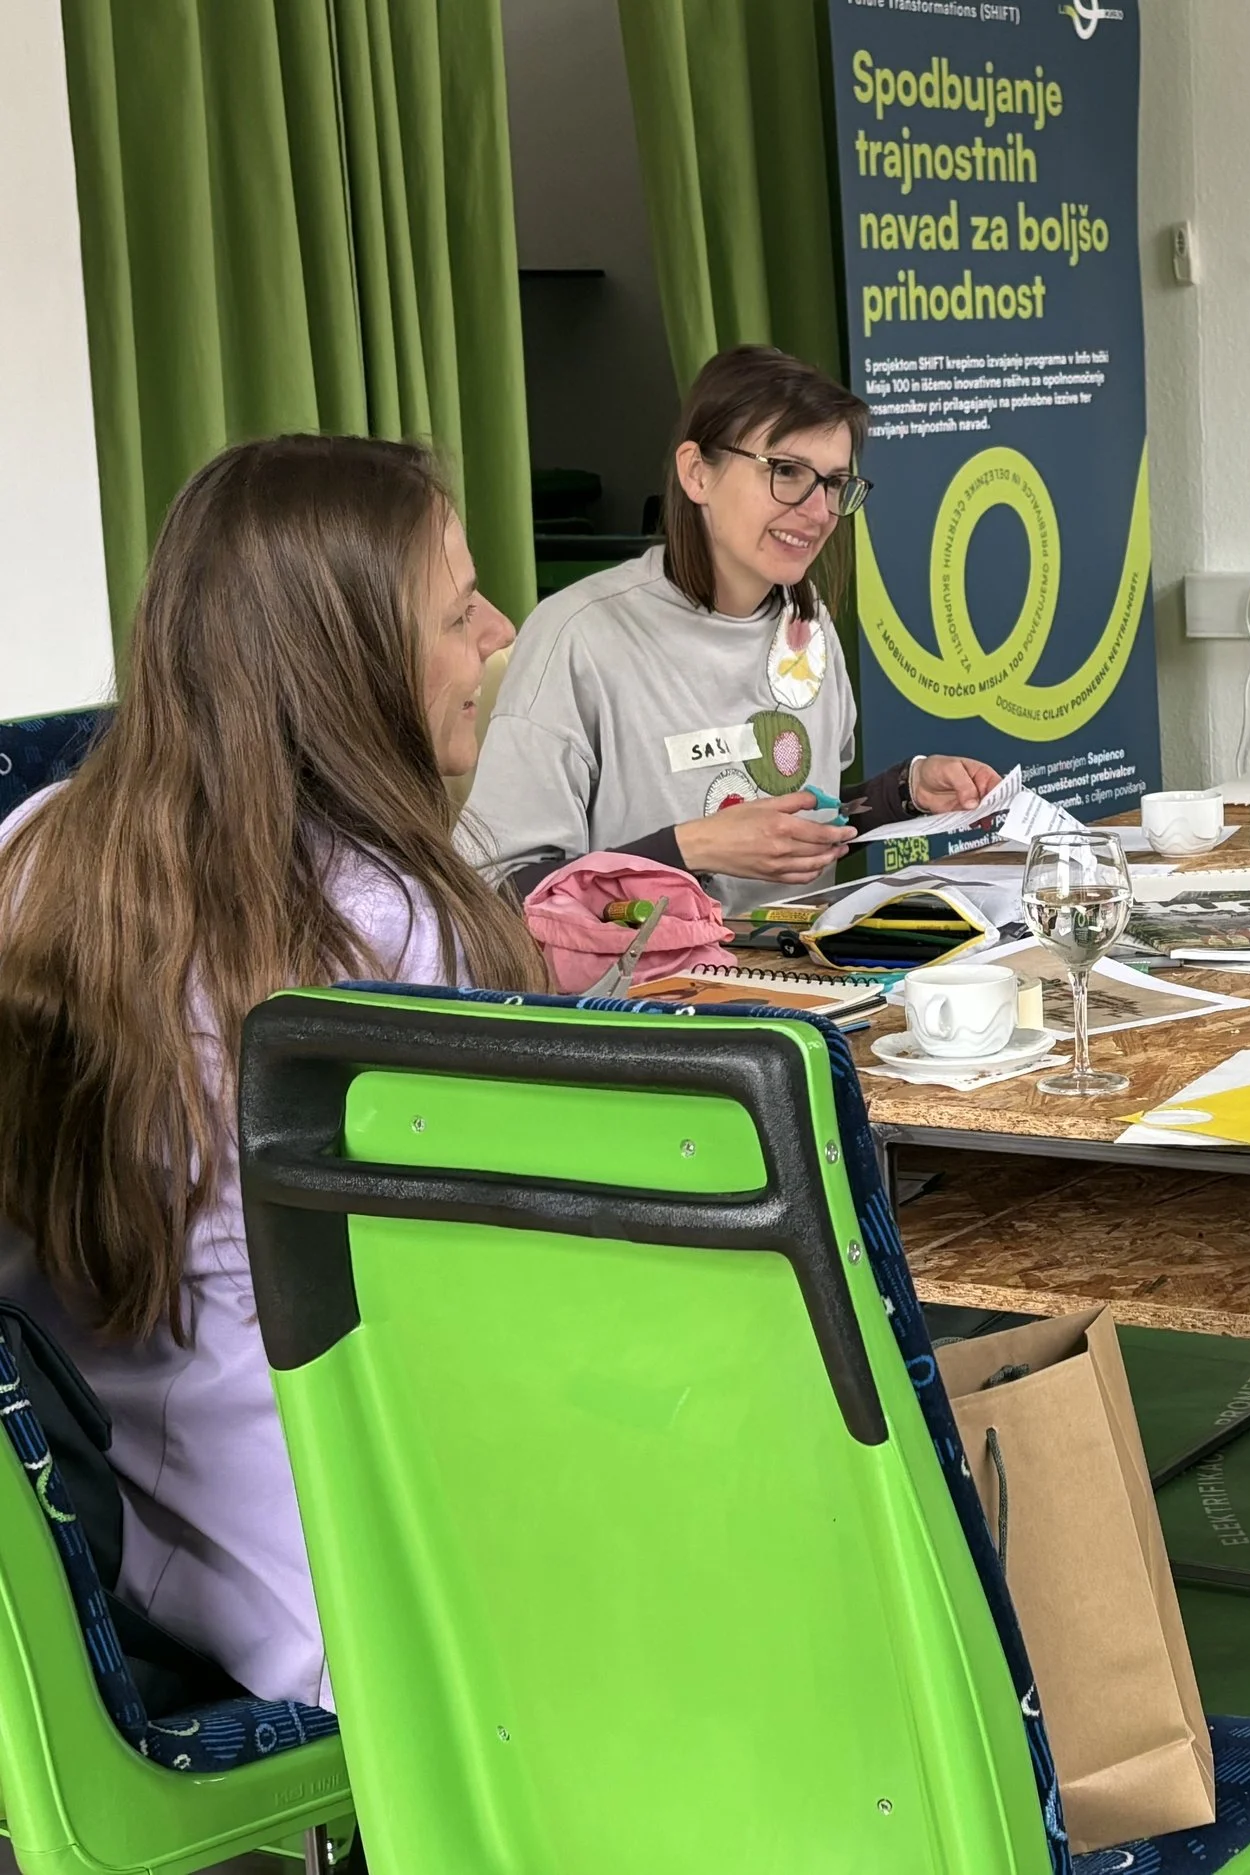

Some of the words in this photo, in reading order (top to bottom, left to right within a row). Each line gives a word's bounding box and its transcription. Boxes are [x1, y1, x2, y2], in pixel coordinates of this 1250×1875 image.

[979, 6, 1020, 25] (SHIFT)
[852, 49, 1064, 131] Spodbujanje
[855, 126, 1037, 195] trajnostnih
[859, 199, 960, 251] navad
[970, 214, 1009, 251] za
[1017, 201, 1110, 267] boljšo
[862, 269, 1046, 338] prihodnost
[872, 357, 918, 376] projektom
[918, 355, 945, 371] SHIFT
[945, 355, 986, 373] krepimo
[986, 353, 1023, 371] izvajanje
[1024, 354, 1067, 370] programa
[1067, 355, 1074, 365] v
[892, 377, 910, 393] 100
[910, 377, 921, 392] in
[921, 377, 953, 392] iščemo
[953, 374, 1002, 390] inovativne
[1002, 373, 1030, 388] rešitve
[1031, 376, 1042, 387] za
[928, 397, 942, 416] pri
[998, 397, 1011, 409] na
[1011, 392, 1053, 412] podnebne
[1053, 391, 1079, 406] izzive
[1079, 391, 1092, 404] ter
[910, 417, 958, 437] trajnostnih
[958, 415, 991, 432] navad.
[941, 573, 964, 656] SKUPNOSTI
[1022, 561, 1051, 653] POVEZUJEMO
[881, 629, 918, 678] MOBILNO
[960, 654, 972, 674] ZA
[1008, 650, 1025, 673] 100
[917, 672, 941, 694] INFO
[942, 682, 977, 698] TOČKO
[978, 668, 1010, 693] MISIJA
[995, 694, 1042, 721] DOSEGANJE
[1041, 703, 1070, 720] CILJEV
[1070, 661, 1111, 711] PODNEBNE
[1047, 755, 1087, 777] partnerjem
[1086, 747, 1126, 767] Sapience
[1037, 773, 1090, 796] ozaveščenost
[1090, 764, 1137, 786] prebivalcev
[1084, 794, 1090, 804] s
[1113, 779, 1148, 800] povišanja
[947, 833, 991, 857] kakovosti
[1197, 1452, 1250, 1547] ELEKTRIFIKAC
